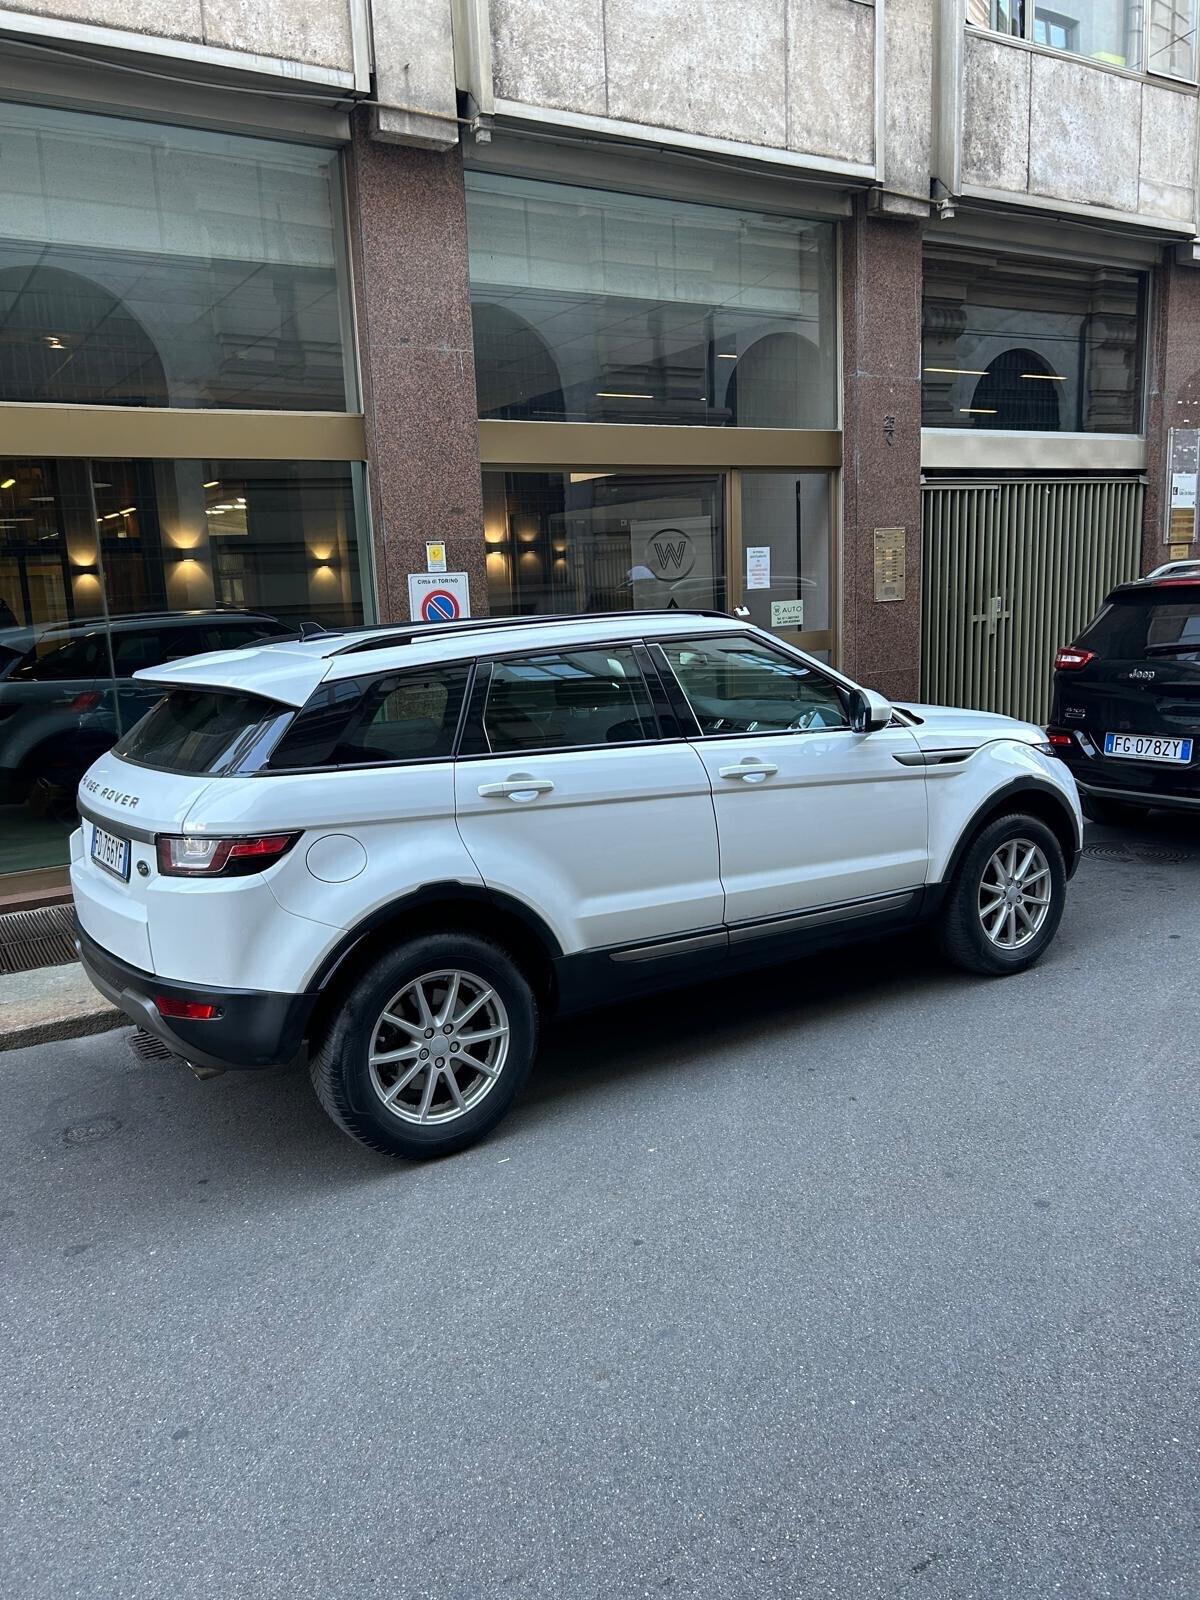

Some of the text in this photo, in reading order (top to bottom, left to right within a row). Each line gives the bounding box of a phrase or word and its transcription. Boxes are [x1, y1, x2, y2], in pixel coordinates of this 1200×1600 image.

[654, 541, 687, 570] W
[782, 605, 802, 613] AUTO
[1128, 668, 1155, 681] Jeep
[100, 787, 140, 809] ROVER
